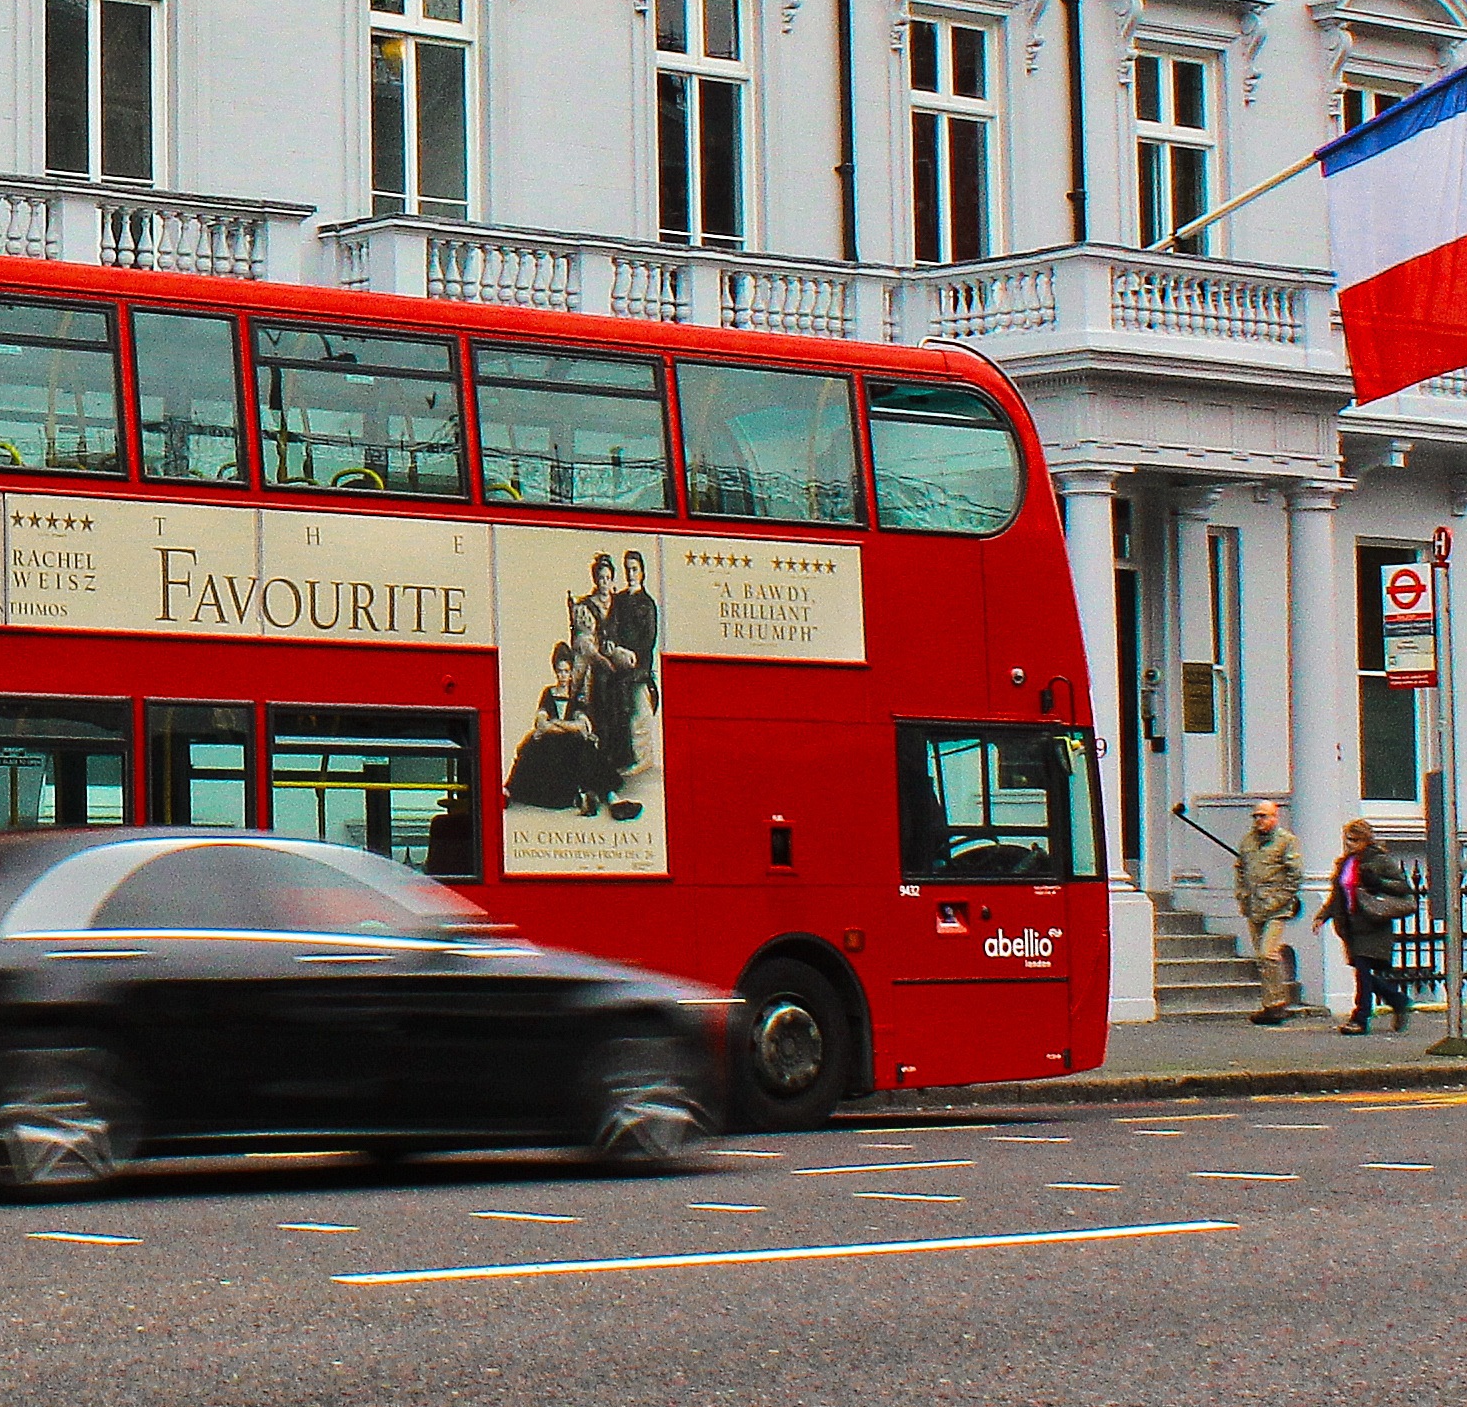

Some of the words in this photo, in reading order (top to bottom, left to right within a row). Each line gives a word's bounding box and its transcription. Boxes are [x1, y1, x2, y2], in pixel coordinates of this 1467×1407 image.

[1435, 531, 1446, 556] H
[12, 549, 97, 571] RACHEL
[12, 570, 97, 592] WEISZ
[153, 547, 467, 635] FAVOURITE
[720, 601, 812, 622] BRILLIANT
[513, 831, 528, 843] IN
[538, 832, 605, 844] CINEMAS
[612, 832, 639, 847] JAN
[899, 885, 920, 897] 9432
[984, 928, 1053, 958] abellio
